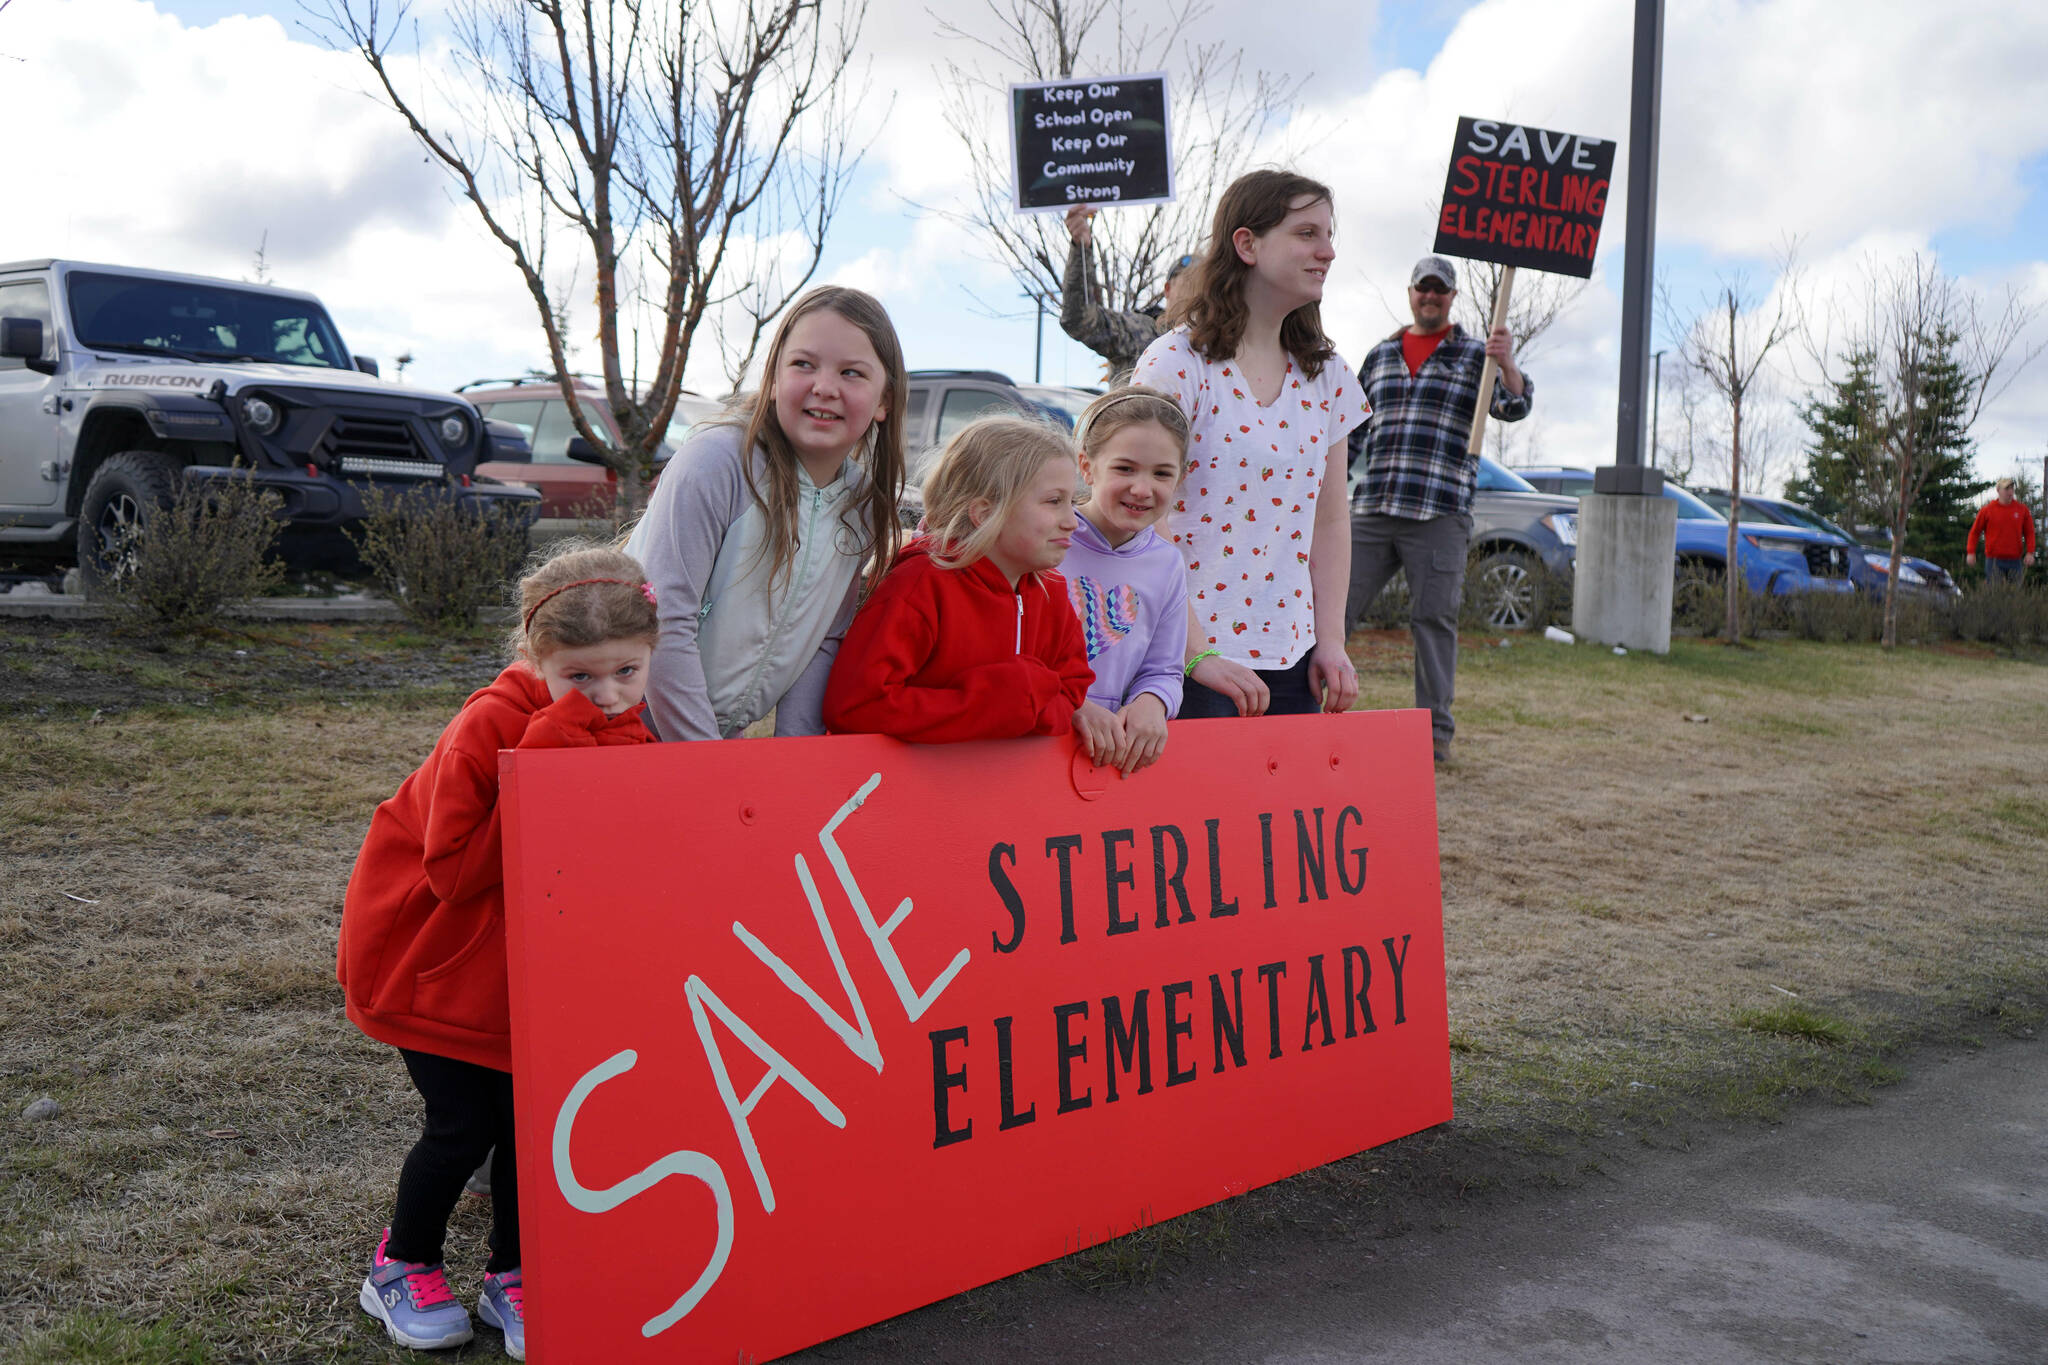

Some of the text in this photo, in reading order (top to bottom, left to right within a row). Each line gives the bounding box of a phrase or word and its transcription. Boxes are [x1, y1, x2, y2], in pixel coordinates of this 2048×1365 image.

[1043, 83, 1120, 105] Keep Our
[1034, 108, 1133, 129] School Open
[1051, 132, 1128, 155] Keep Our
[1467, 119, 1603, 170] SAVE
[1043, 157, 1135, 178] Community
[1452, 154, 1609, 217] STERLING
[1065, 185, 1121, 201] Strong
[1439, 203, 1601, 260] ELEMENTARY
[103, 373, 205, 388] RUBICON
[987, 804, 1370, 955] STERLING
[552, 772, 971, 1338] SAVE
[928, 933, 1413, 1150] ELEMENTARY
